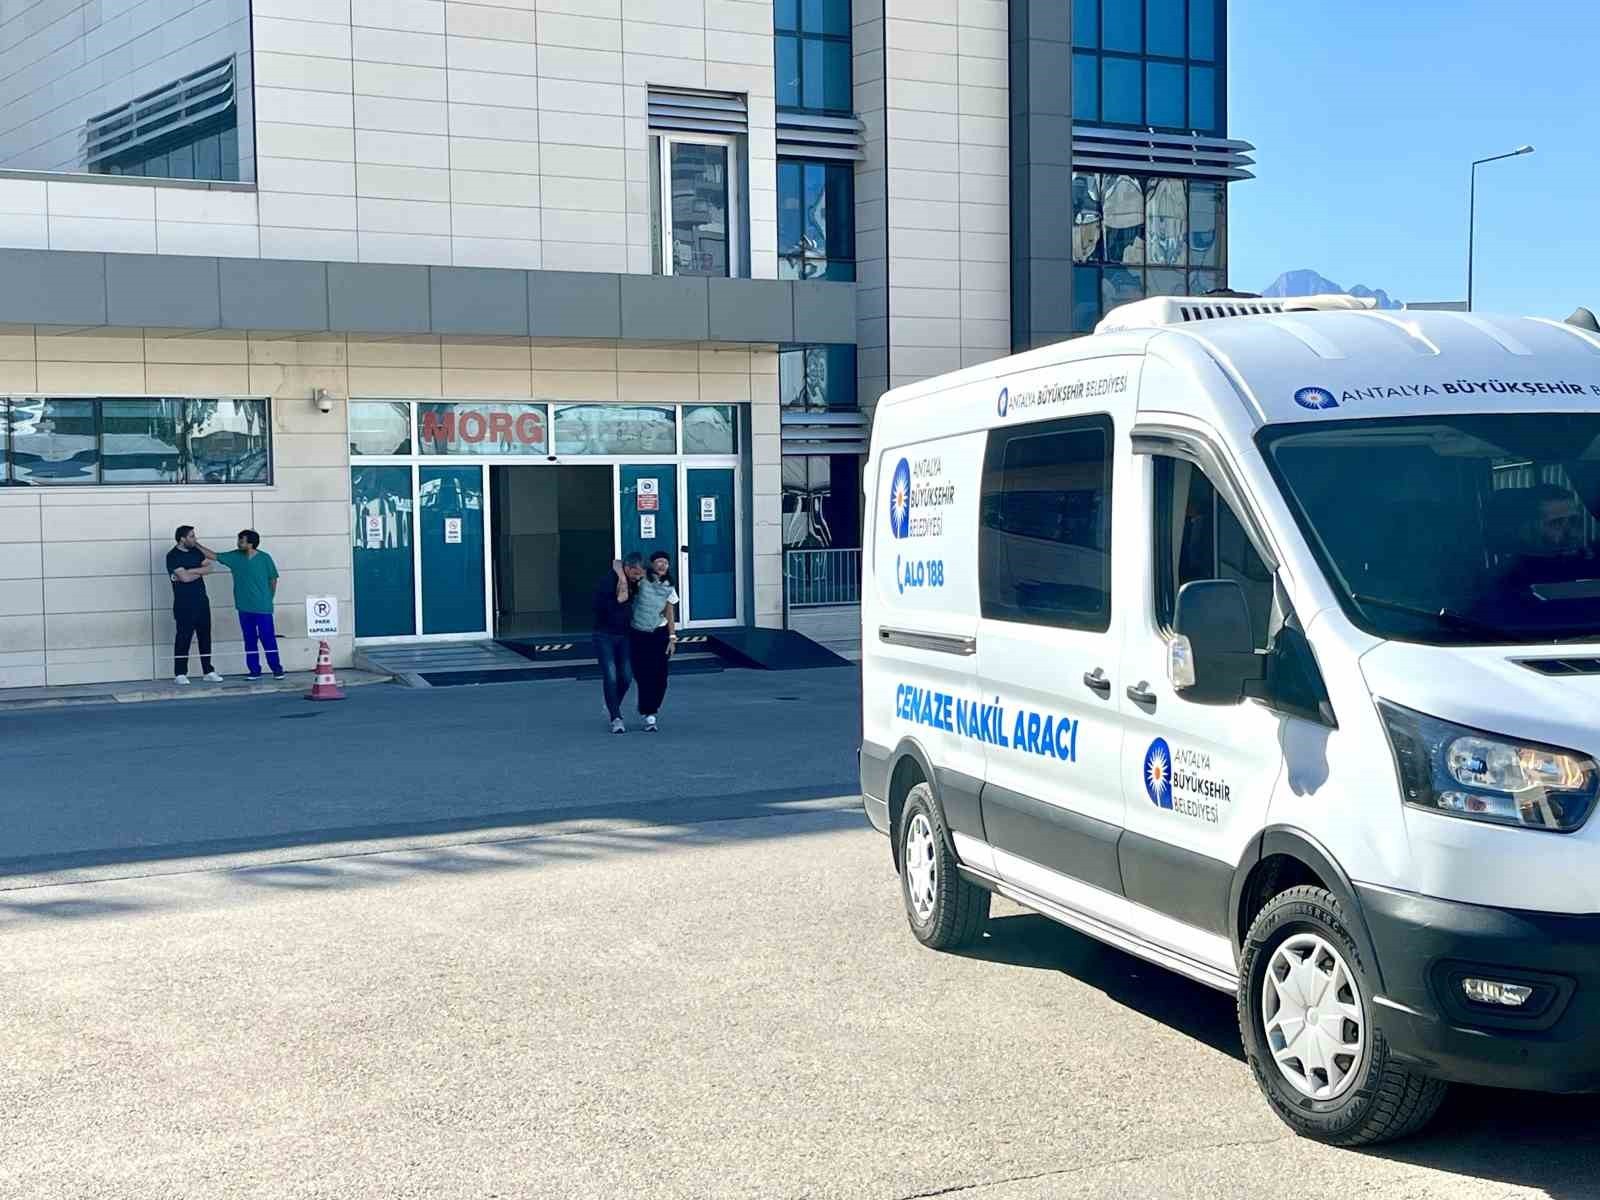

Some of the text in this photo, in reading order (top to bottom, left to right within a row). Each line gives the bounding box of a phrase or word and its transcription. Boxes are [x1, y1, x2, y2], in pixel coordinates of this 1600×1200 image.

[1009, 391, 1036, 410] ANTALYA
[1341, 384, 1439, 402] ANTALYA
[1442, 379, 1586, 396] BÜYÜKŞEHİR
[423, 411, 544, 445] MORG
[913, 457, 942, 478] ANTALYA
[911, 480, 955, 510] BÜYÜKŞEHİR
[904, 559, 944, 587] ALO 188
[896, 683, 1079, 762] CENAZE NAKİL ARACI
[1174, 748, 1211, 771] ANTALYA
[1172, 771, 1231, 803] BÜYÜKŞEHİR
[1173, 798, 1219, 825] BELEDİYESİ
